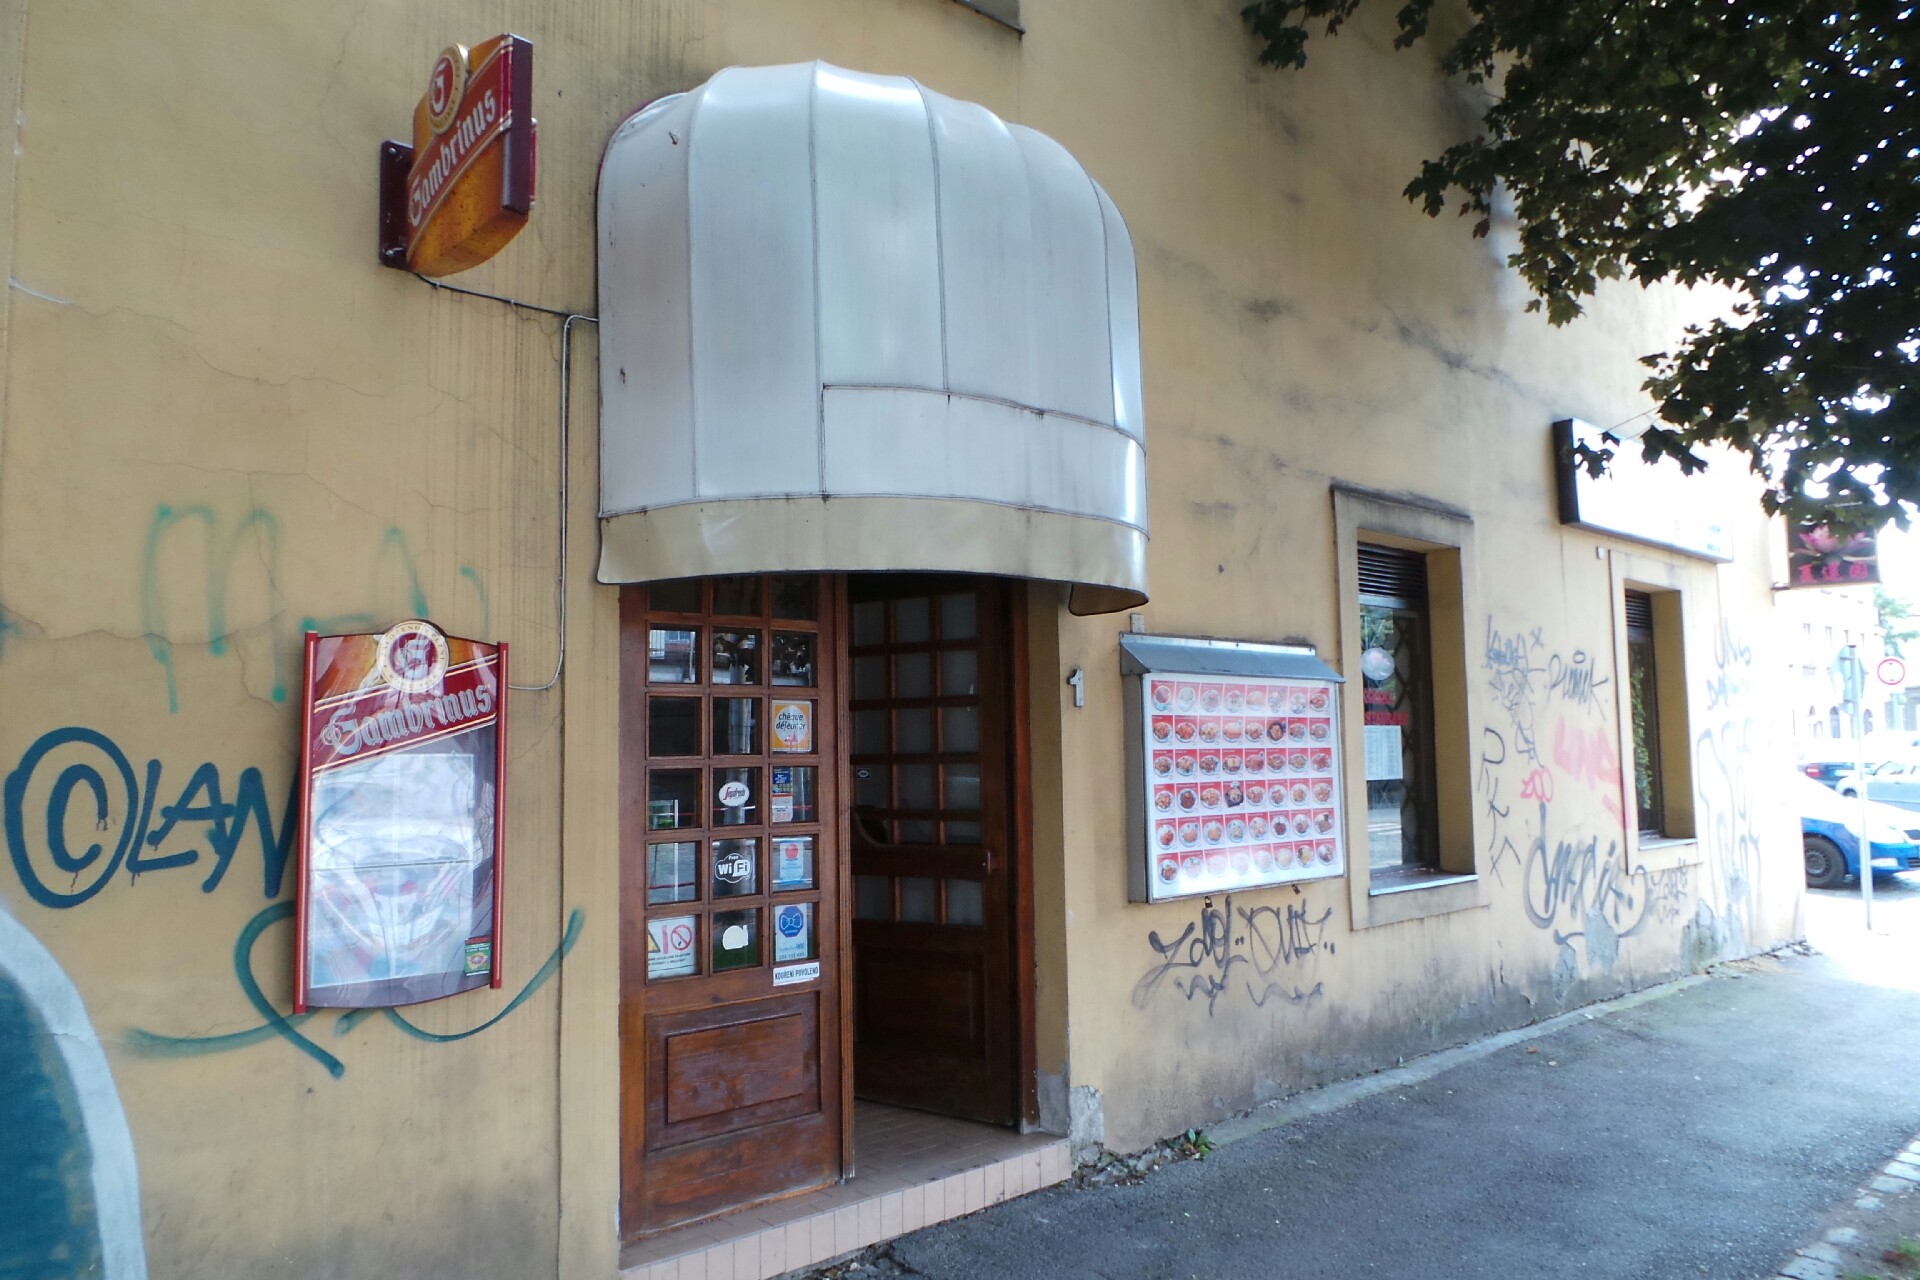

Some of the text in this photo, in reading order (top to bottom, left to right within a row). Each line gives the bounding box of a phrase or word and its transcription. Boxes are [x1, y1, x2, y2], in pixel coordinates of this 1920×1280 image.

[408, 89, 497, 227] Gambrinus
[1067, 668, 1084, 708] 1
[321, 684, 491, 755] Gambrinus
[795, 966, 819, 977] POVOLENO
